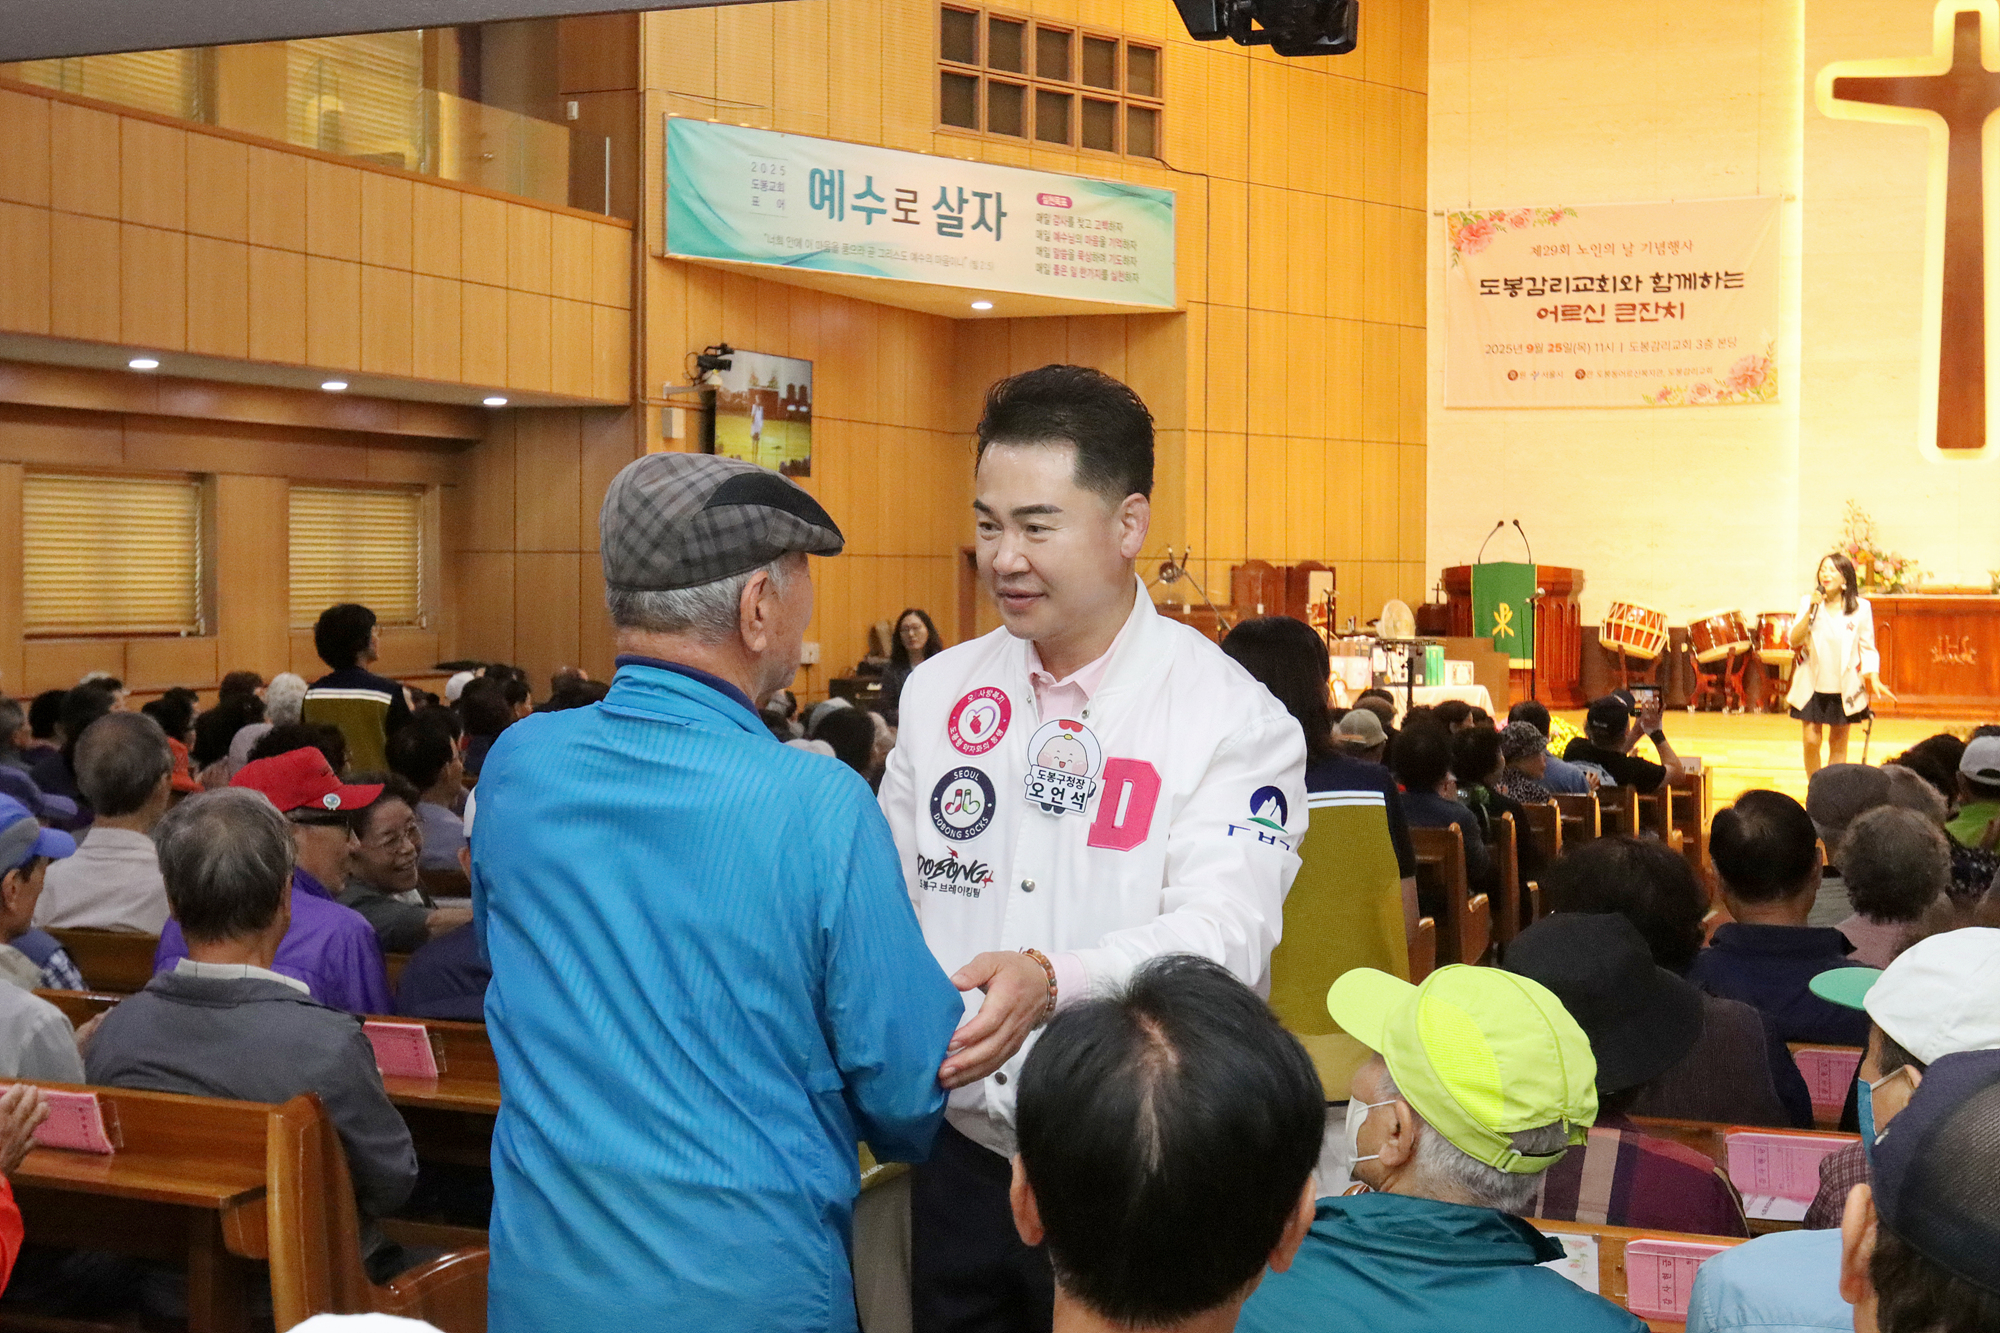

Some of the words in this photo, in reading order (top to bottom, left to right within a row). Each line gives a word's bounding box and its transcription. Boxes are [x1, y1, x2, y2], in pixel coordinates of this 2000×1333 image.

[751, 161, 785, 176] 2025
[809, 167, 920, 225] 예수로
[932, 186, 1007, 242] 살자
[1532, 243, 1570, 257] 제29회
[1577, 242, 1615, 258] 노인의
[1622, 241, 1634, 257] 날
[1641, 239, 1692, 256] 기념행사
[1480, 274, 1643, 298] 도봉감리교회와
[1649, 270, 1744, 293] 함께하는
[1536, 303, 1605, 323] 어르신
[1615, 301, 1684, 323] 큰잔치
[1485, 343, 1522, 355] 2025년
[1526, 342, 1543, 354] 9월
[1595, 341, 1614, 354] 11시
[1629, 338, 1692, 352] 도봉감리교회
[954, 769, 979, 781] SEOUL
[1037, 769, 1085, 790] 도봉구청장
[1087, 757, 1162, 852] D
[934, 813, 962, 839] DOBONG
[965, 816, 989, 838] SOCKS
[917, 853, 989, 884] DOBONG
[939, 883, 981, 898] 브레이킹팀
